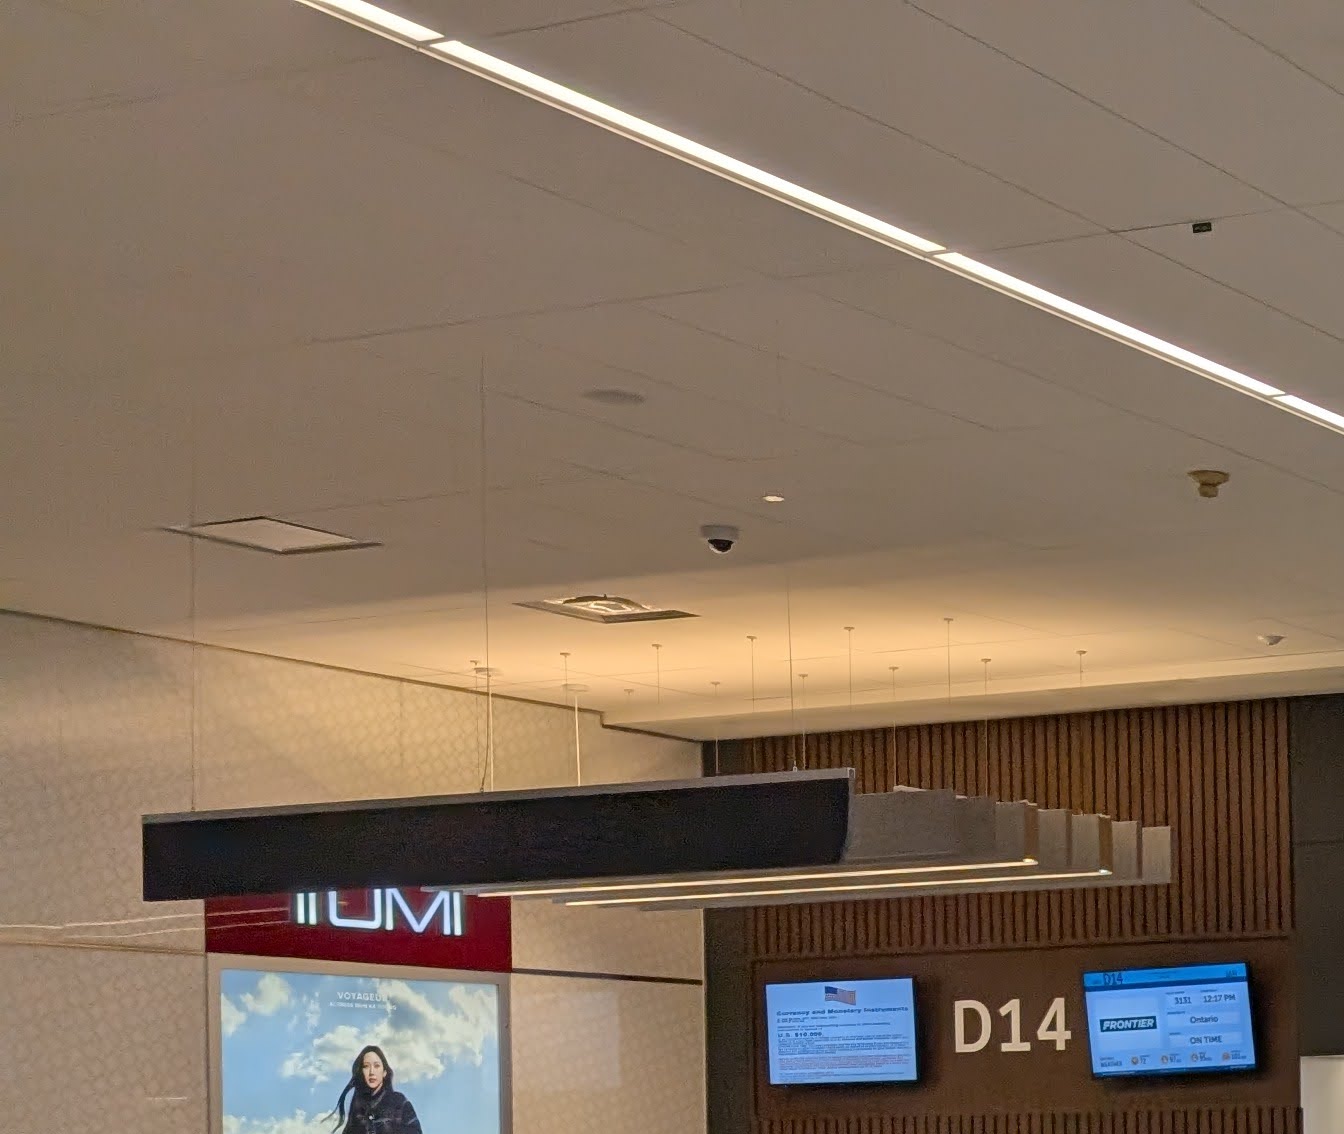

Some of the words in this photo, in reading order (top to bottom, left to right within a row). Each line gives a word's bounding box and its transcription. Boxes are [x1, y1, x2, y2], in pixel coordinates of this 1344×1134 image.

[1103, 973, 1124, 986] D14
[1203, 994, 1223, 1004] 12:17
[1224, 993, 1237, 1002] PM
[954, 997, 1072, 1053] D14
[1102, 1017, 1155, 1031] FRONTIER
[1190, 1015, 1219, 1024] Ontario
[1190, 1036, 1202, 1045] ON
[1204, 1035, 1223, 1044] TIME
